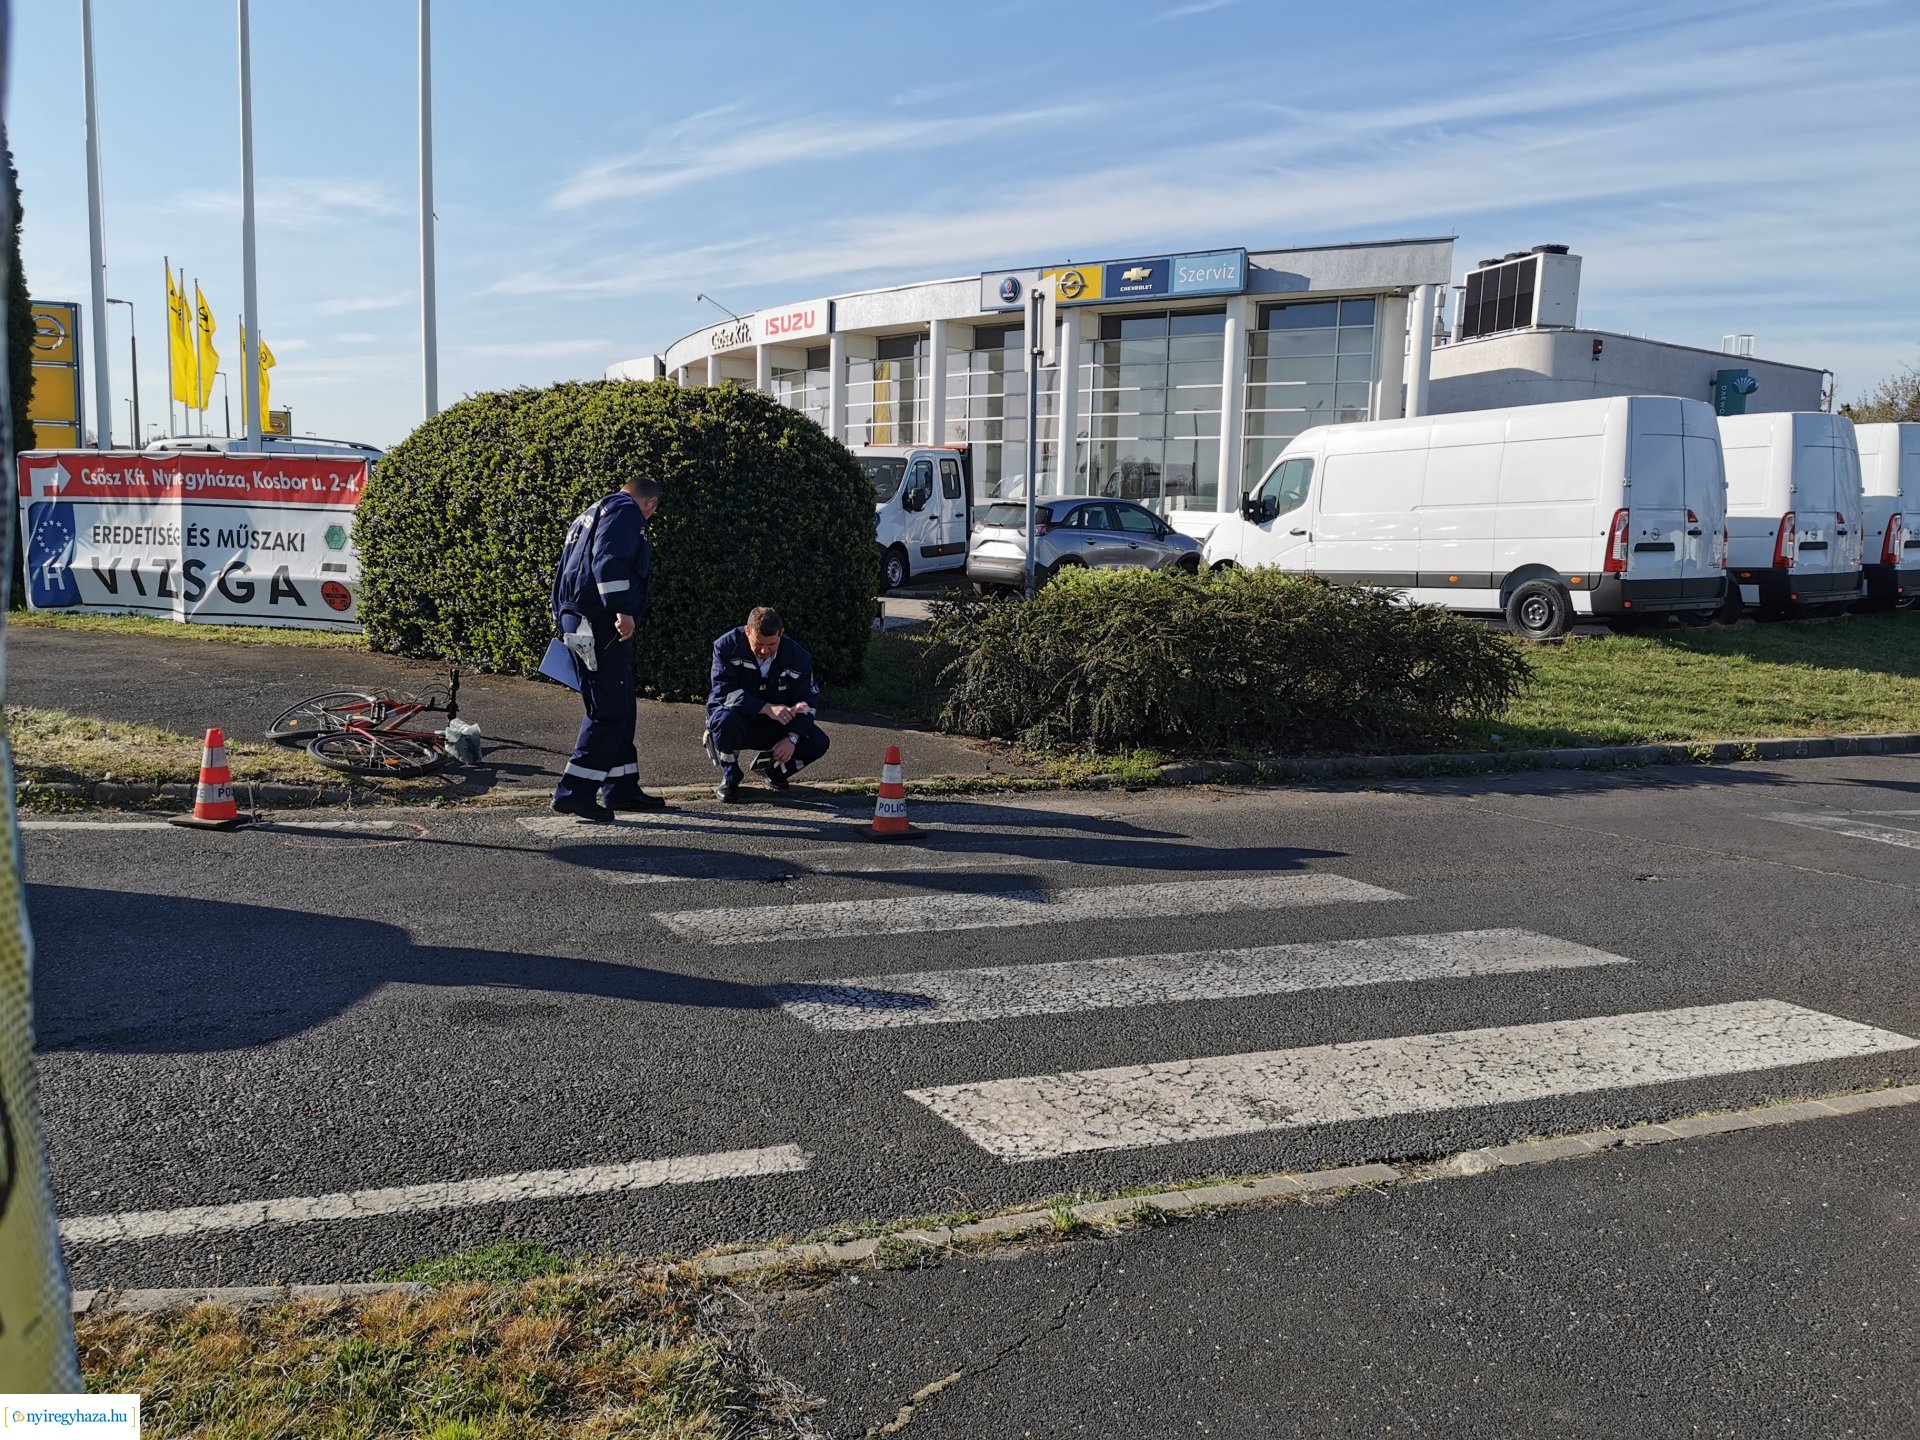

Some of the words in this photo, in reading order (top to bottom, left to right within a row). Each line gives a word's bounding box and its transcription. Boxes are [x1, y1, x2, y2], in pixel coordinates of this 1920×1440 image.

[1179, 263, 1236, 284] Szerviz
[1120, 283, 1153, 293] CHEVROLET
[765, 310, 815, 337] ISUZU
[1719, 385, 1727, 414] DAEWO
[80, 467, 122, 486] Csősz
[123, 467, 150, 486] Kft.
[252, 470, 309, 490] Kosbor
[311, 477, 327, 492] u.
[328, 473, 360, 493] 2-4.
[92, 521, 181, 547] EREDETISÉG
[186, 522, 210, 548] ÉS
[216, 523, 306, 553] MŰSZAKI
[91, 556, 308, 608] VIZSGA
